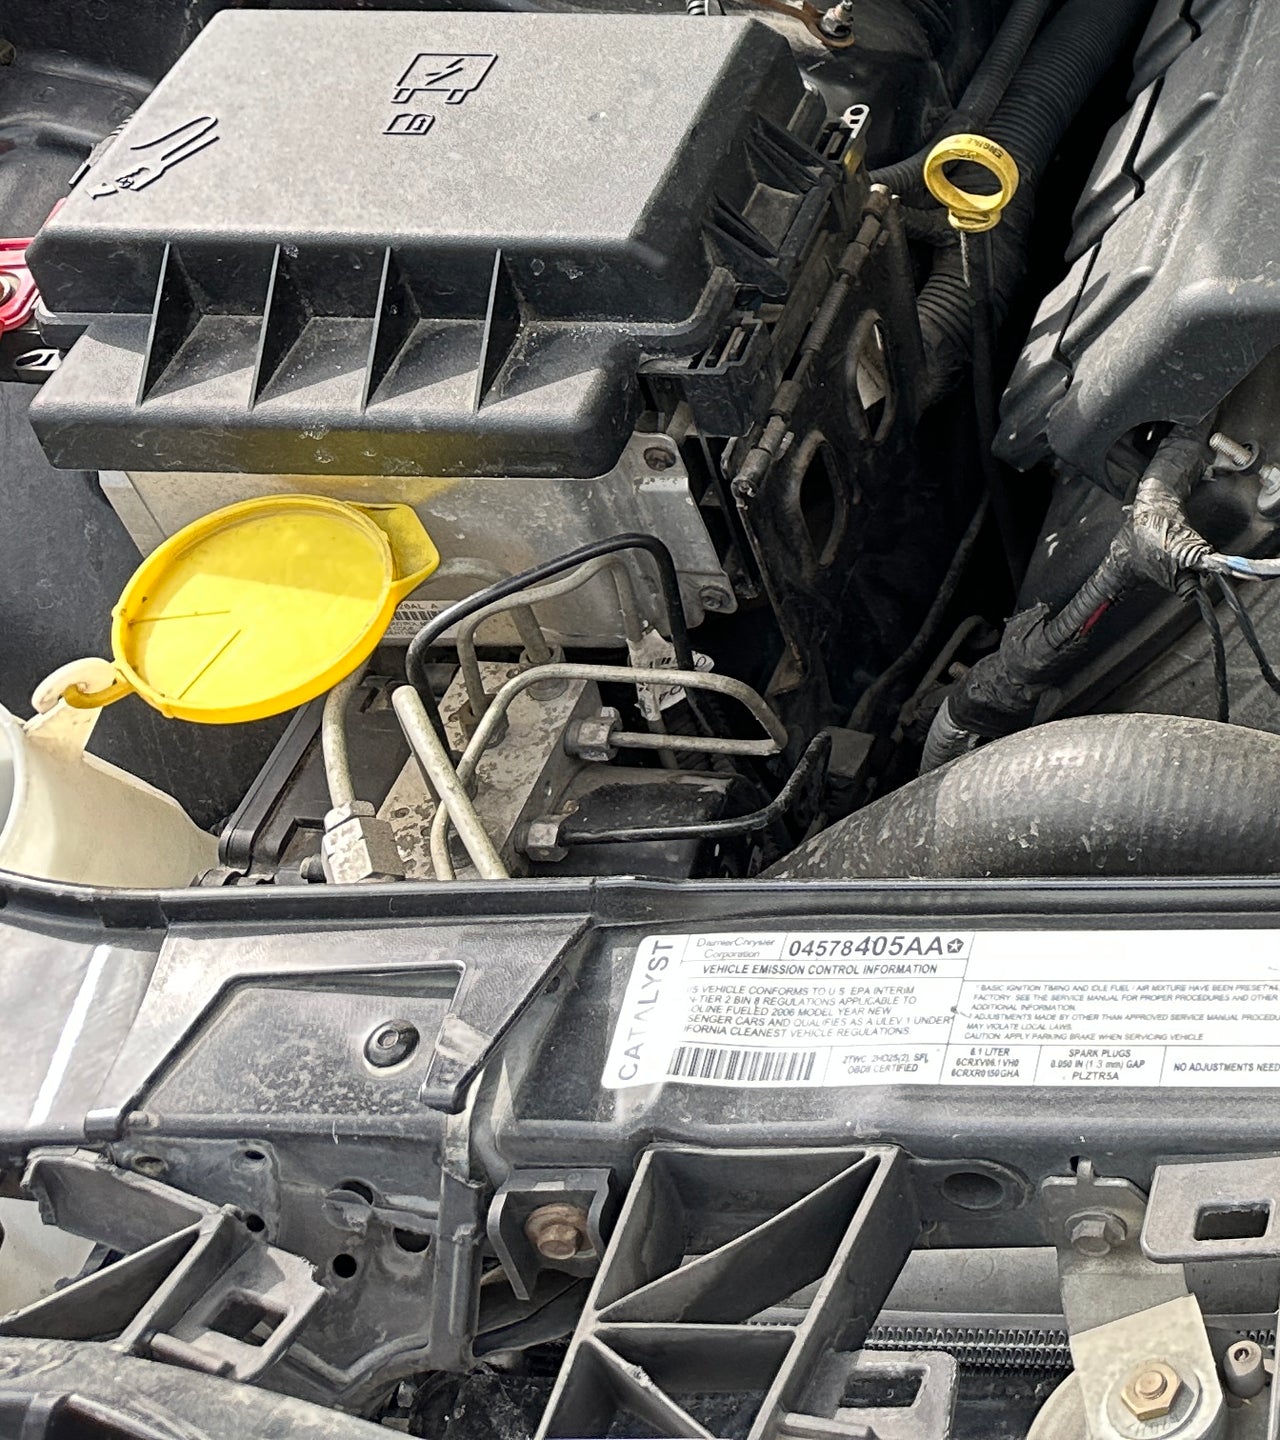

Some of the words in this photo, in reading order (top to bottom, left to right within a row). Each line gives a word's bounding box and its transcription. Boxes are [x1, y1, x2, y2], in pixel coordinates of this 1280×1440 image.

[789, 936, 942, 957] 04578405AA
[703, 964, 749, 974] VEHICLE
[751, 964, 805, 975] EMISSION
[808, 964, 859, 975] CONTROL
[863, 964, 938, 975] INFORMATION
[617, 939, 674, 1081] CATALYST
[1068, 1048, 1099, 1058] SPARK
[1101, 1048, 1131, 1058] PLUGS
[1173, 1062, 1187, 1072] NO
[1189, 1062, 1254, 1072] ADJUSTMENTS
